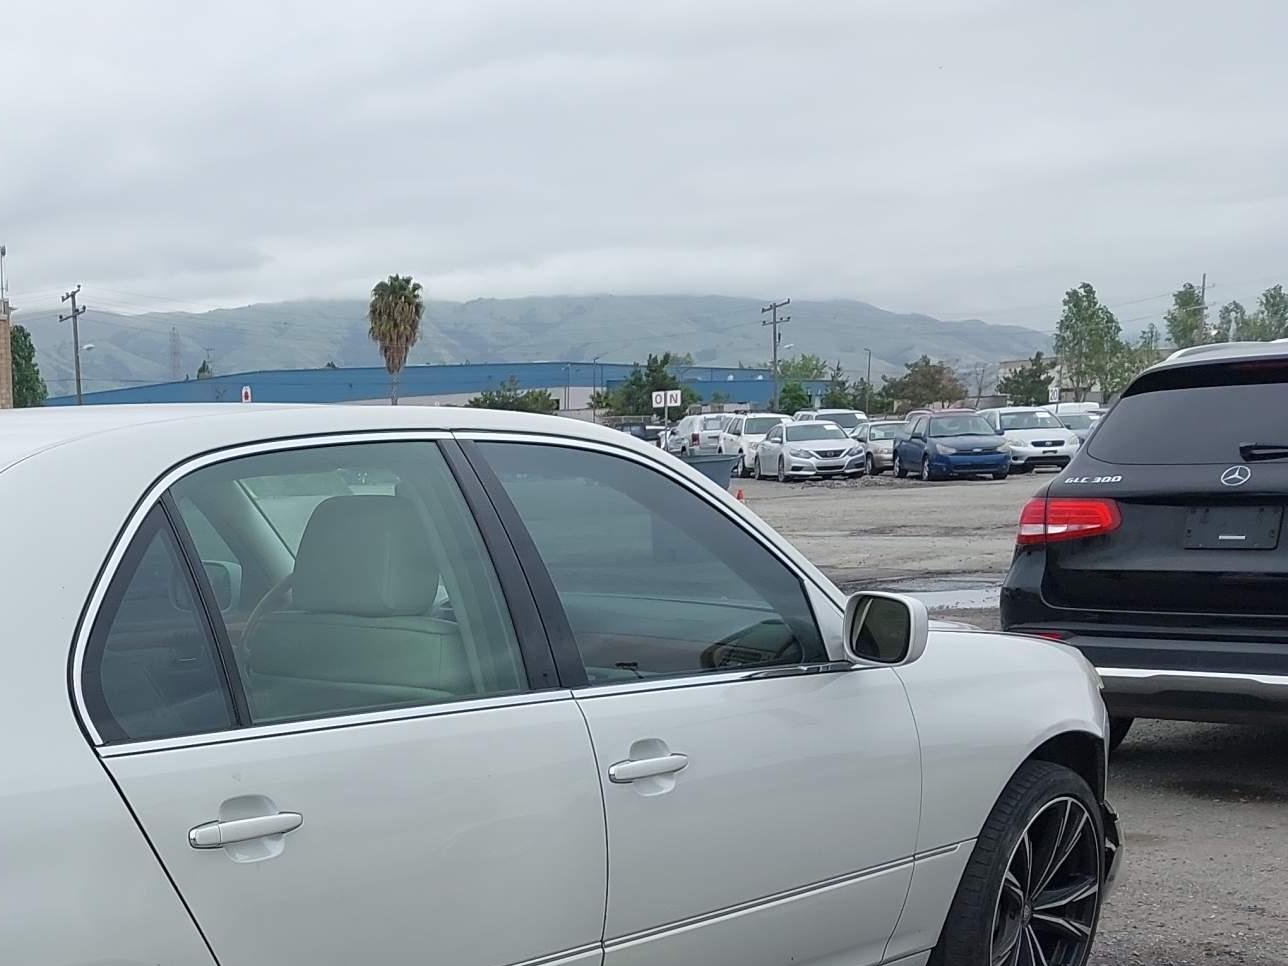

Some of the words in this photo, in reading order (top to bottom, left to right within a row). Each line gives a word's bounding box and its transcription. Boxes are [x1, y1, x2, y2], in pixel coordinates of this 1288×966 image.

[669, 392, 678, 404] N
[1064, 476, 1091, 484] GLC
[1092, 475, 1123, 484] 300
